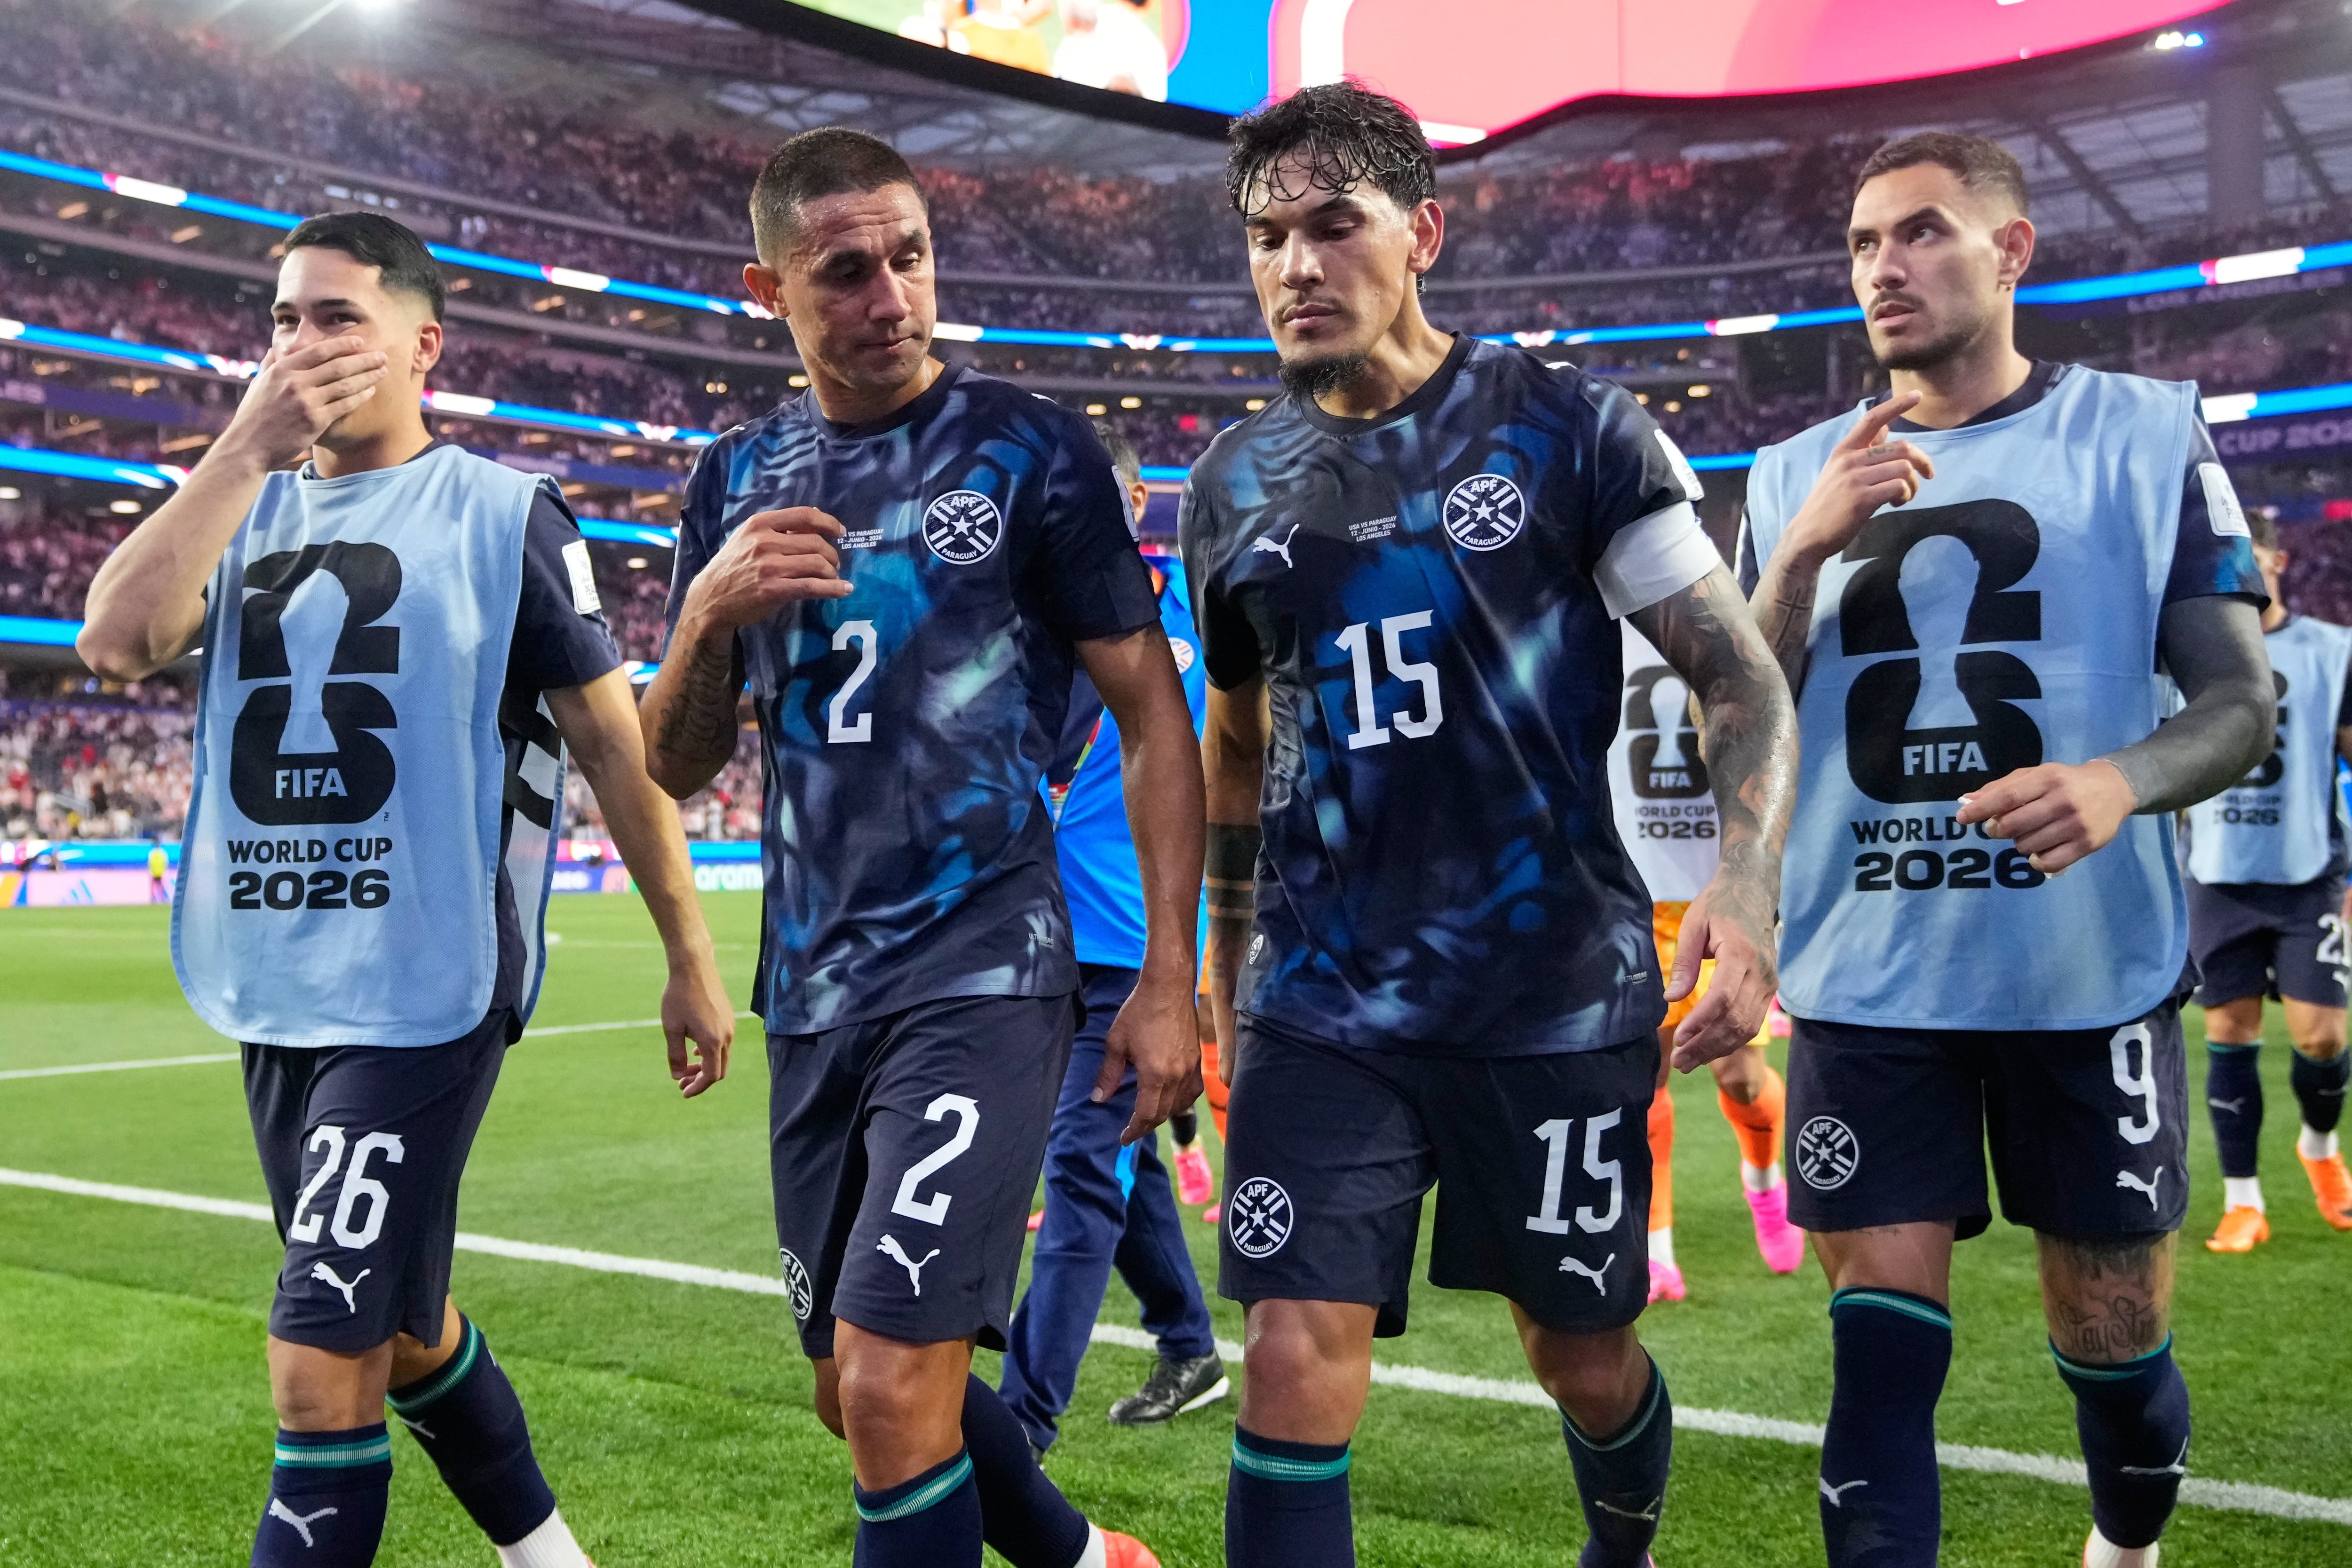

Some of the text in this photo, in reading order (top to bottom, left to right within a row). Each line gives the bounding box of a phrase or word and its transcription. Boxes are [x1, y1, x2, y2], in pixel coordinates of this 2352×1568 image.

[1470, 479, 1498, 493] APF
[950, 496, 977, 508] APF
[1368, 515, 1397, 526] PARAGUAY
[856, 528, 884, 537] PARAGUAY
[1361, 526, 1378, 534] JUNIO
[1367, 530, 1391, 539] ANGELES
[1464, 534, 1502, 546] PARAGUAY
[941, 547, 978, 560] PARAGUAY
[827, 619, 877, 744] 2
[1334, 609, 1443, 750] 15
[1903, 741, 1988, 776] FIFA
[275, 767, 348, 800] FIFA
[1648, 771, 1692, 789] FIFA
[1636, 805, 1716, 818] ORLD CUP
[1851, 816, 1968, 845] WORLD
[227, 837, 393, 864] WORLD CUP
[1853, 847, 2046, 893] 2026
[229, 869, 391, 911] 2026
[2109, 1022, 2160, 1145] 9
[1812, 1121, 1832, 1135] APF
[890, 1093, 980, 1226] 2
[1525, 1106, 1622, 1235] 15
[291, 1124, 405, 1250] 26
[1247, 1183, 1268, 1197] APF
[1243, 1241, 1273, 1253] PARAGUAY
